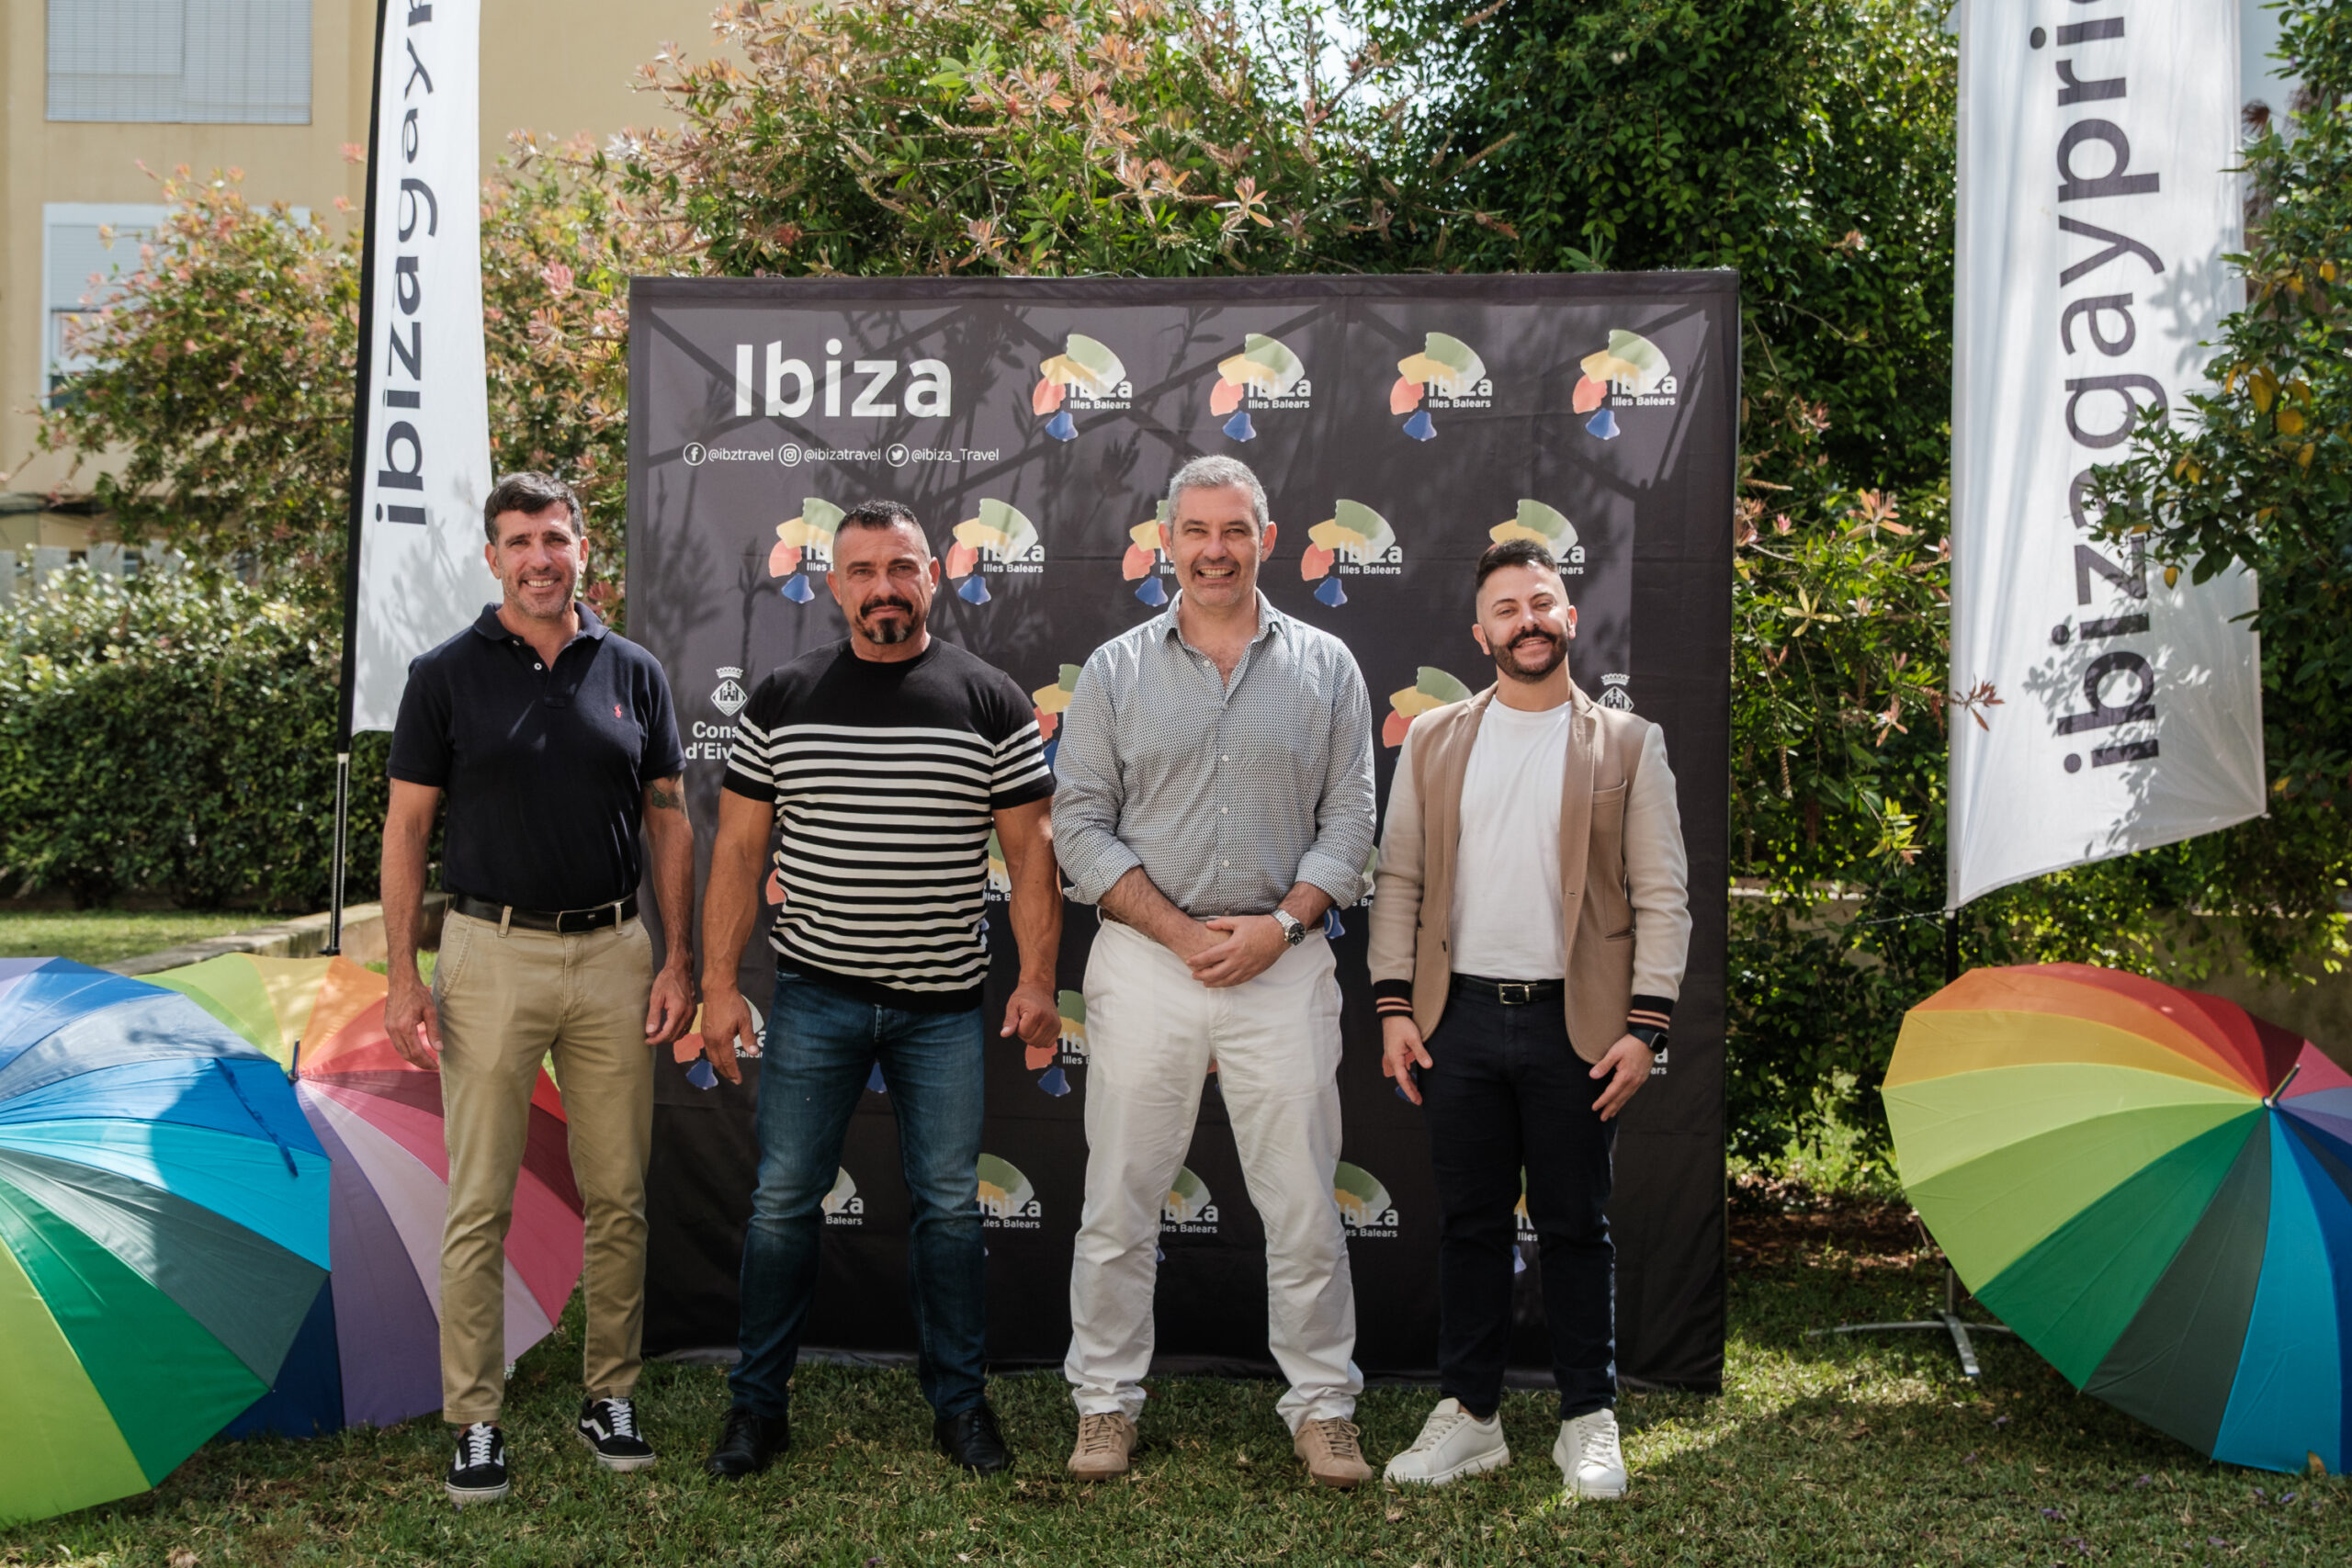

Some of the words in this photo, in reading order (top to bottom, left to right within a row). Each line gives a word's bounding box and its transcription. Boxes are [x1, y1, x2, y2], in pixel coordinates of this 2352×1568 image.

[736, 338, 952, 418] Ibiza
[1070, 400, 1091, 410] Illes
[1093, 400, 1131, 410] Balears
[1249, 400, 1270, 409] Illes
[1272, 400, 1310, 409] Balears
[1429, 399, 1450, 408] Illes
[1453, 399, 1491, 408] Balears
[1611, 396, 1634, 406] Illes
[1636, 396, 1676, 406] Balears
[708, 447, 774, 462] @ibztravel
[804, 447, 881, 463] @ibizatravel
[911, 447, 1000, 463] @ibiza_Travel
[807, 562, 827, 571] Illes
[983, 563, 1004, 572] Illes
[1006, 563, 1044, 573] Balears
[1340, 565, 1361, 574] Illes
[1363, 565, 1402, 575] Balears
[826, 1215, 864, 1225] Balears
[1003, 1219, 1041, 1229] Balears
[1180, 1224, 1218, 1234] Balears
[1360, 1228, 1398, 1237] Balears
